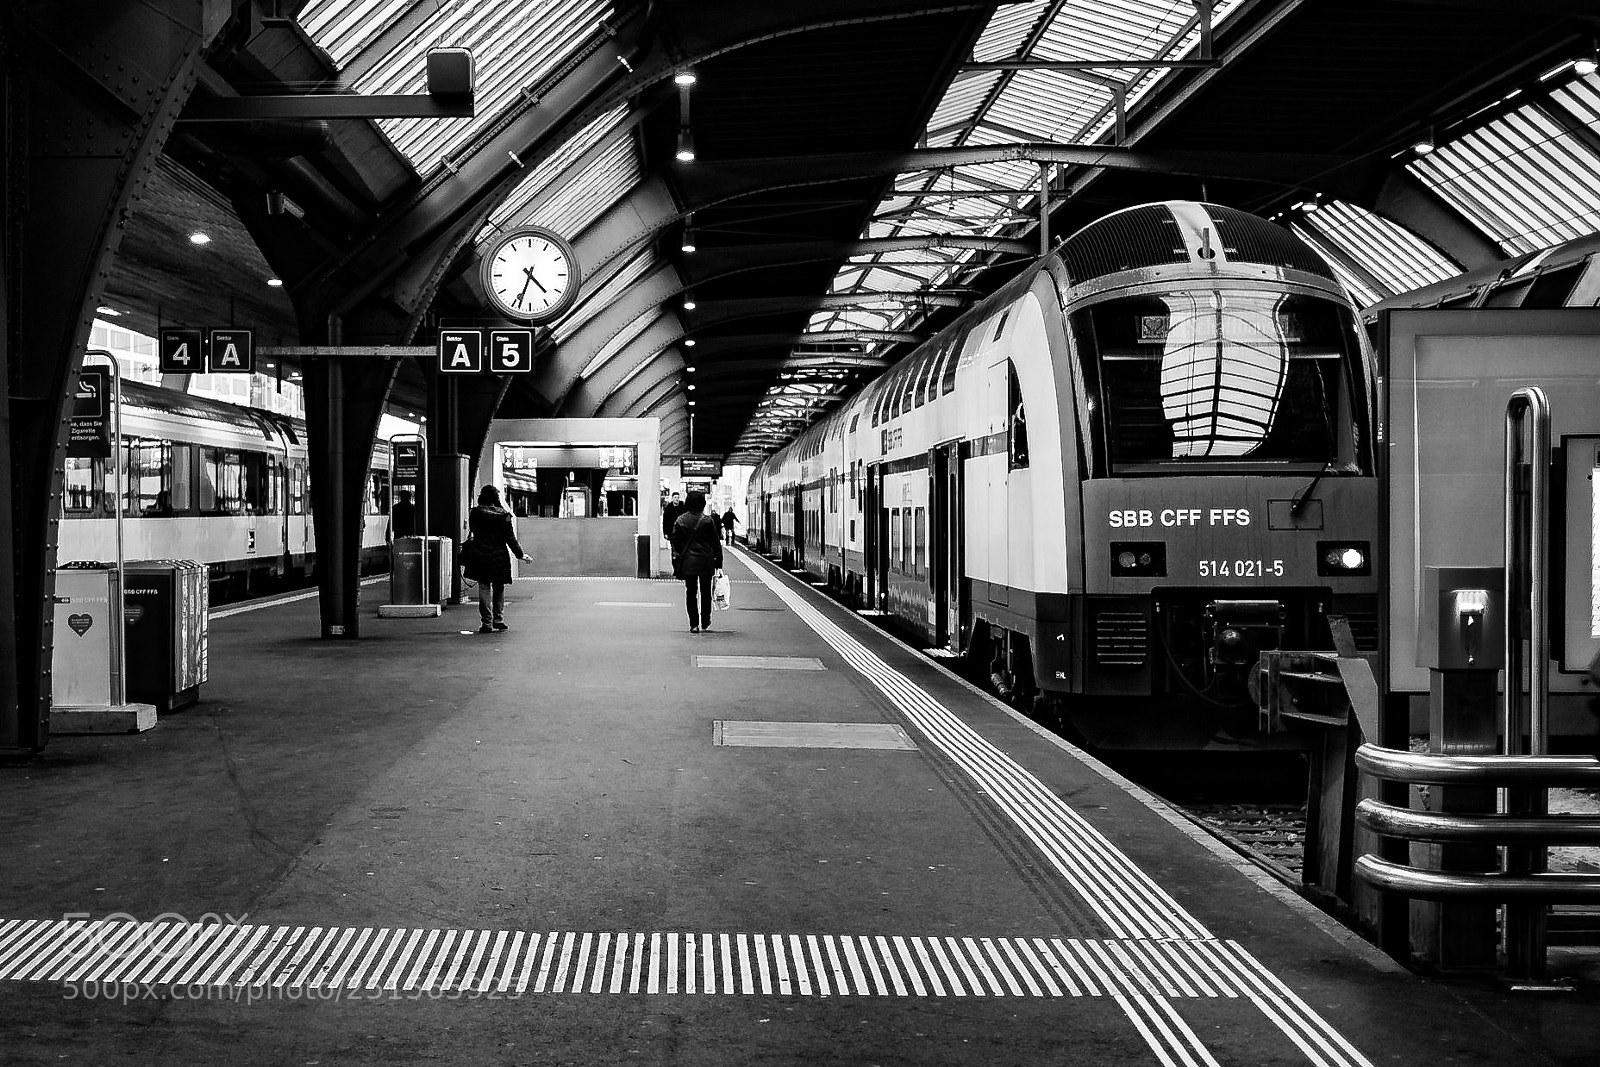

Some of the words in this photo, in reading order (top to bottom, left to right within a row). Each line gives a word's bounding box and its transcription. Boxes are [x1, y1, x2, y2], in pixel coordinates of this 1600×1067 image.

[172, 342, 191, 366] 4
[221, 343, 241, 366] A
[450, 343, 471, 367] A
[502, 343, 520, 367] 5
[1109, 509, 1154, 527] SBB
[1160, 509, 1202, 527] CFF
[1209, 508, 1251, 526] FFS
[1199, 560, 1230, 577] 514
[1234, 560, 1284, 577] 021-5
